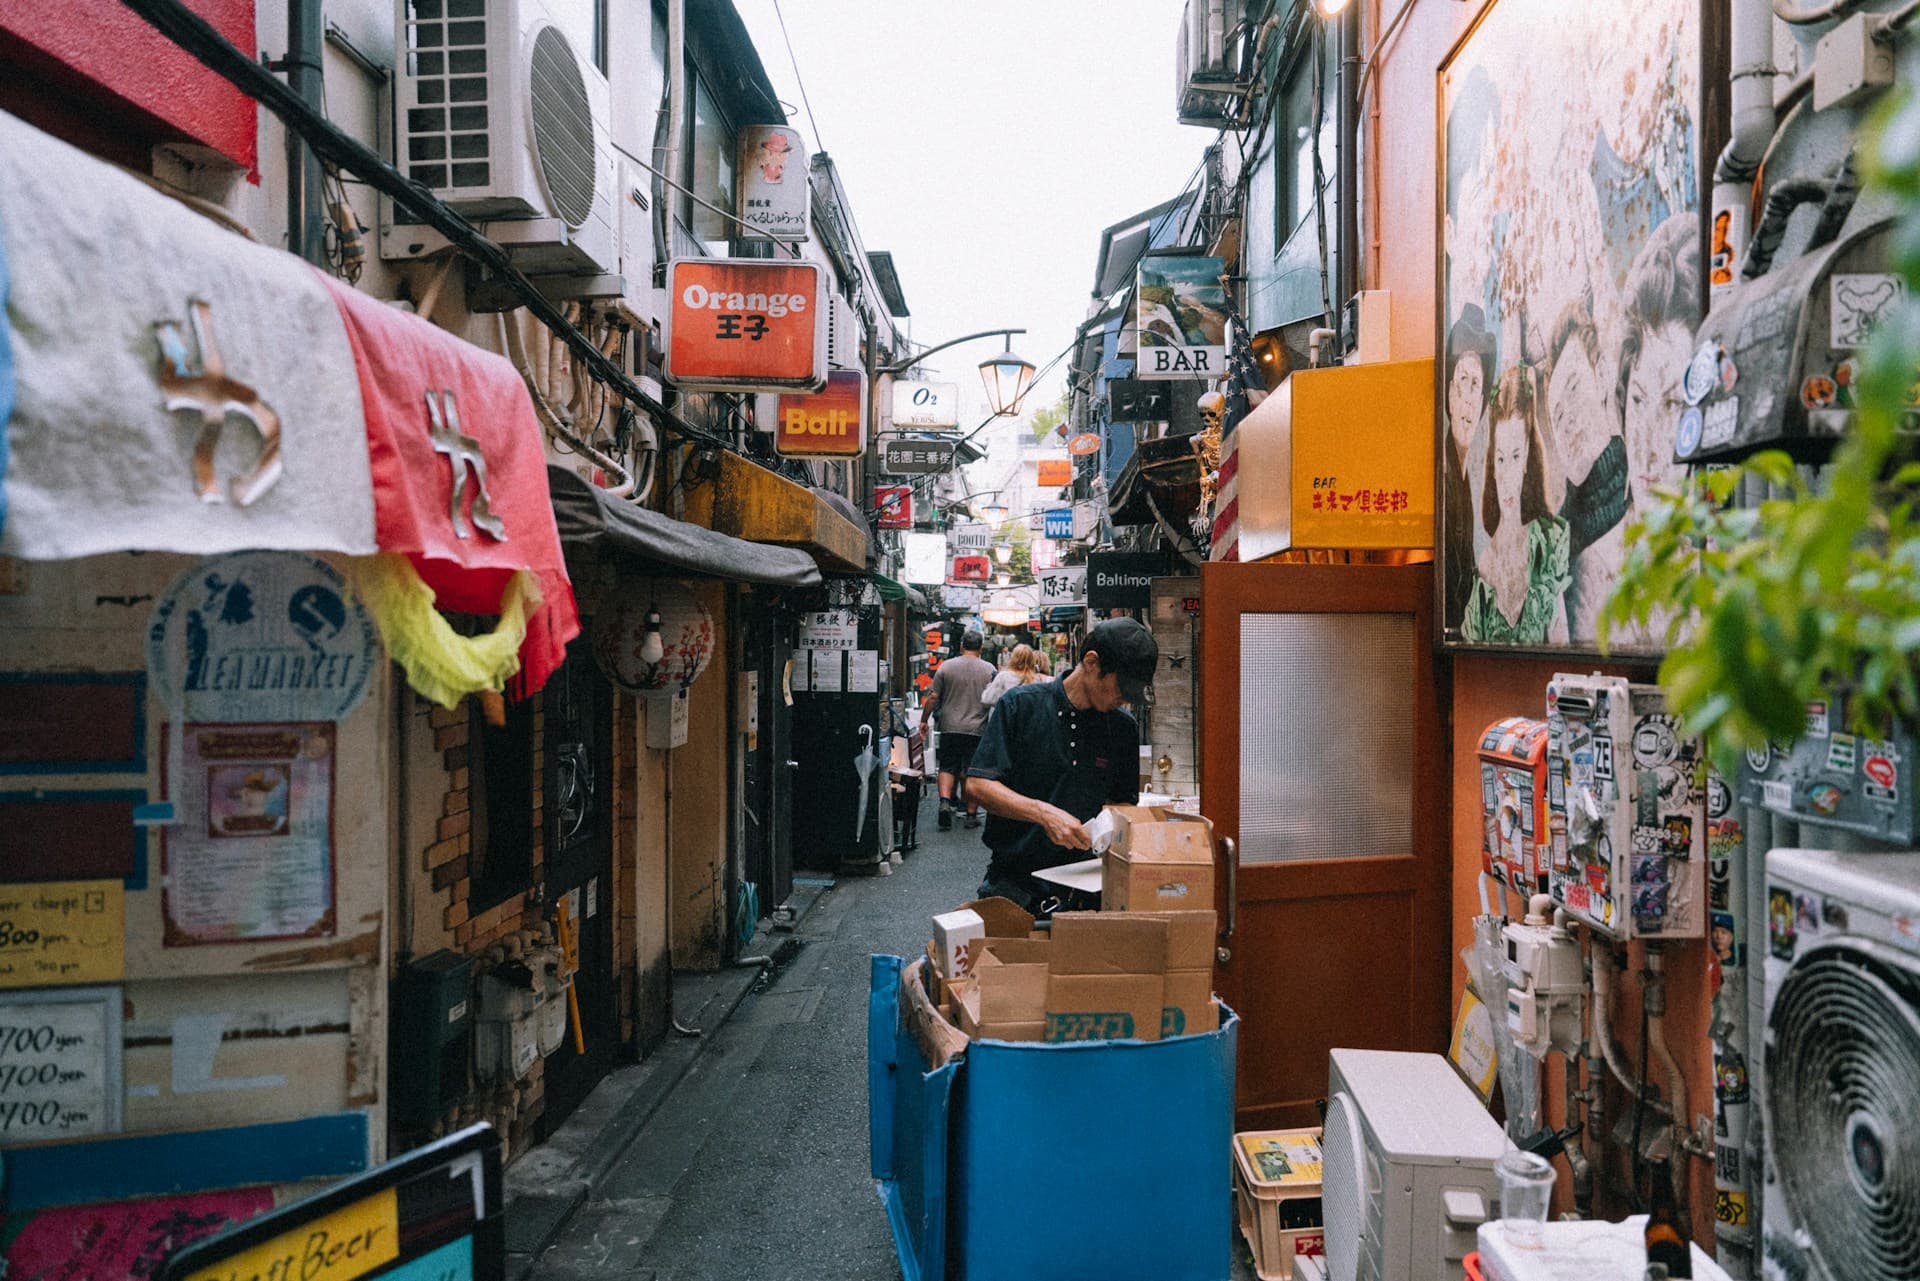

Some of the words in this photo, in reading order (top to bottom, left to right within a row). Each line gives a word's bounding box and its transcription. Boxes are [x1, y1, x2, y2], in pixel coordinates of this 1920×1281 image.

[683, 284, 807, 318] Orange
[716, 314, 770, 341] 王子
[1154, 350, 1210, 371] BAR
[785, 408, 848, 436] Bali
[888, 450, 953, 464] 花園三番街
[1313, 477, 1336, 489] BAR
[56, 1036, 83, 1052] yen
[58, 1070, 86, 1084] yen
[58, 1112, 89, 1129] yen
[300, 1223, 387, 1281] Beer
